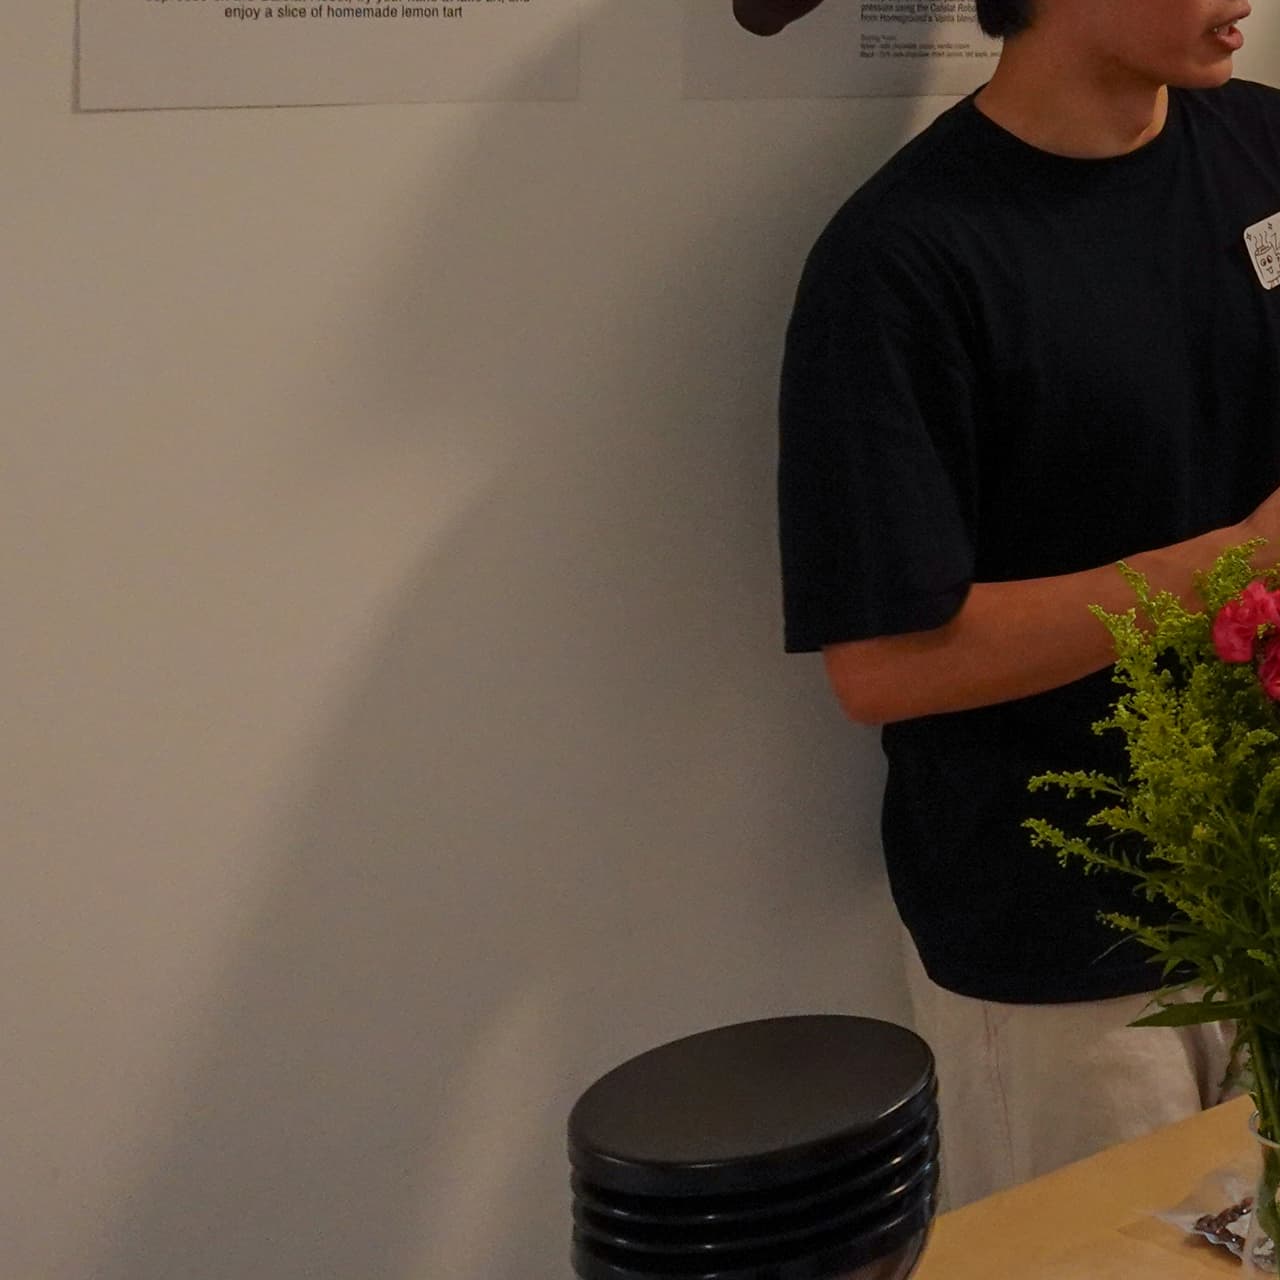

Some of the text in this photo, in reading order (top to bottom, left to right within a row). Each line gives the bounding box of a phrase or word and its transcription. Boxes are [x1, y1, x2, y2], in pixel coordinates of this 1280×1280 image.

[224, 5, 463, 20] enjoy a slice of homemade lemon tart
